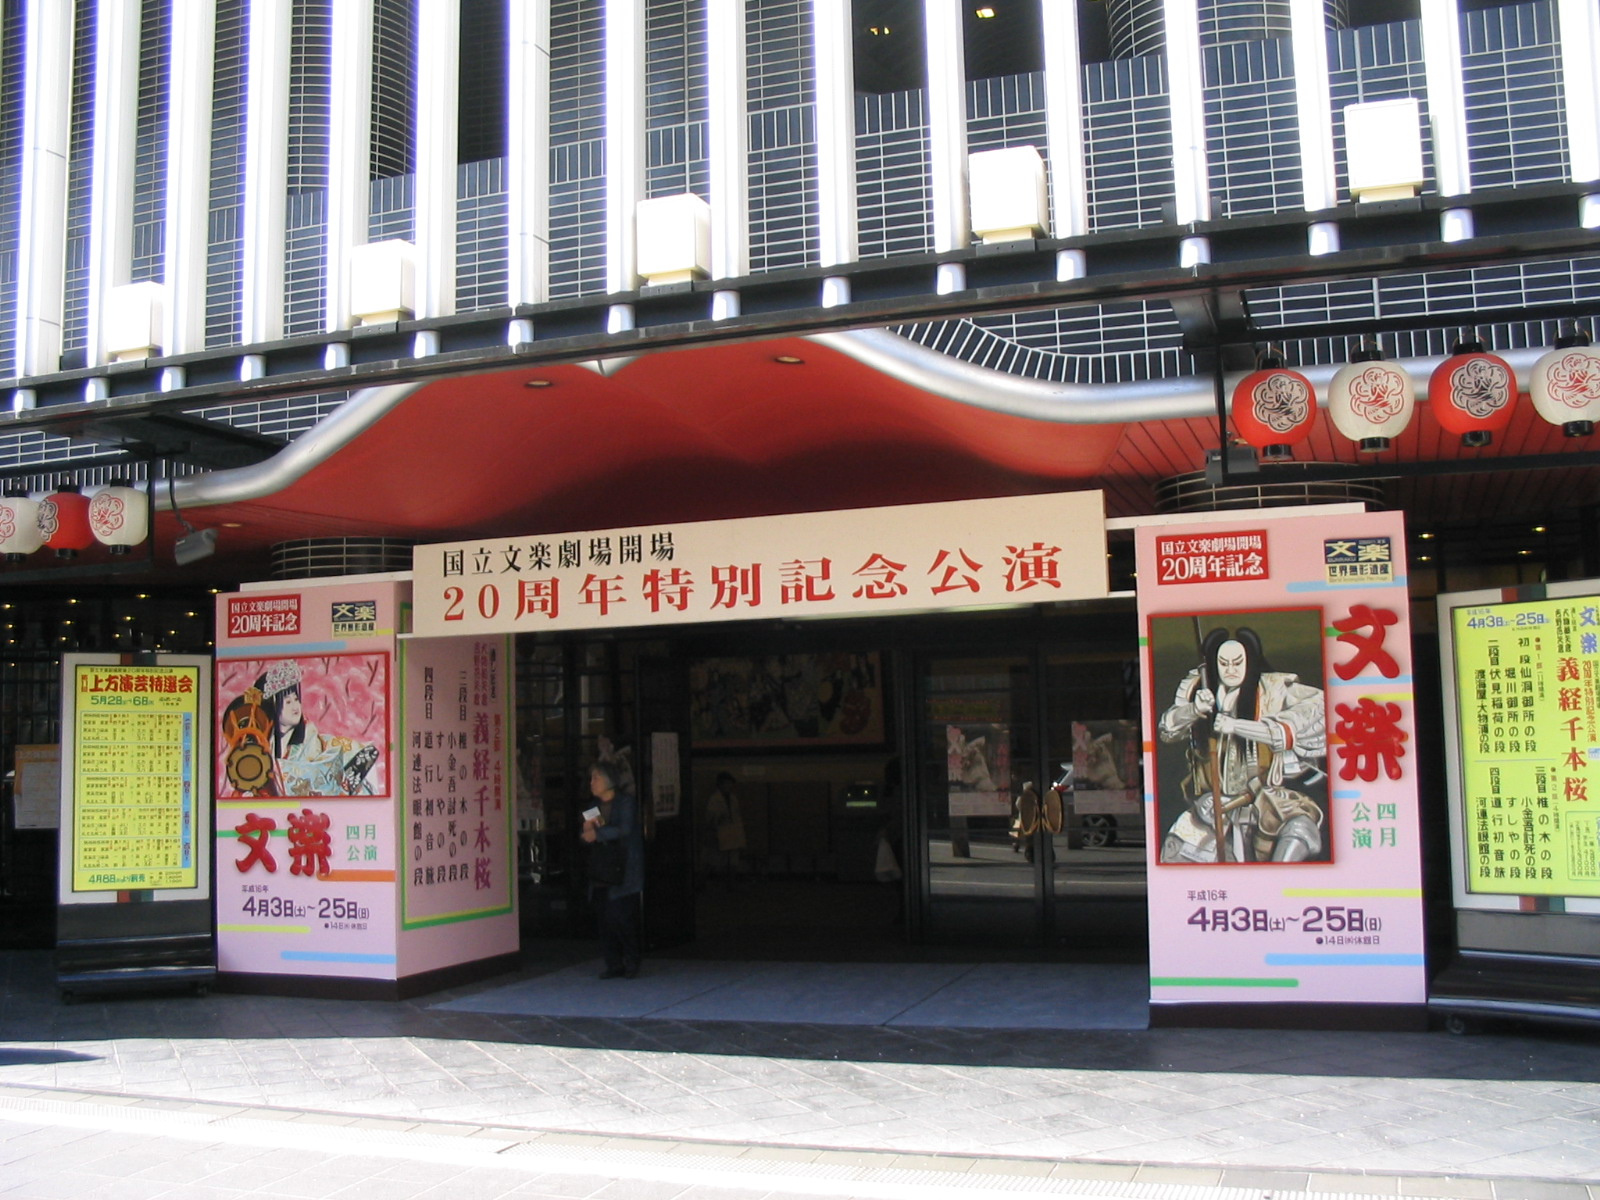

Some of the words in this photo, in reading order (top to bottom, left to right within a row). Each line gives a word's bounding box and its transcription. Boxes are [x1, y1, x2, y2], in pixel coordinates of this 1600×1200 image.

[442, 532, 676, 577] 国立文楽劇場開場
[443, 541, 1063, 621] 20周年特別記念公演
[1161, 535, 1262, 556] 国立文楽劇場開場
[1162, 552, 1264, 581] 20周年記念
[231, 598, 298, 614] 国立文楽劇場開場
[231, 612, 298, 635] 20周年記念
[424, 666, 434, 719] 四段目
[1490, 668, 1506, 753] 伏見稲荷の段
[1505, 667, 1521, 753] 堀川御所の段
[1520, 667, 1537, 752] 仙洞御所の段
[1557, 657, 1589, 802] 義経千本桜
[436, 730, 447, 884] すしやの段
[473, 712, 491, 891] 義経千本桜
[1489, 767, 1501, 794] 四段目
[1535, 766, 1547, 793] 三段目
[1476, 797, 1491, 878] 河連法眼館の段
[1491, 797, 1505, 878] 道行初音旅
[1506, 796, 1521, 879] すしやの段
[1522, 797, 1537, 880] 小金吾討死の段
[1187, 889, 1228, 901] 平成16年
